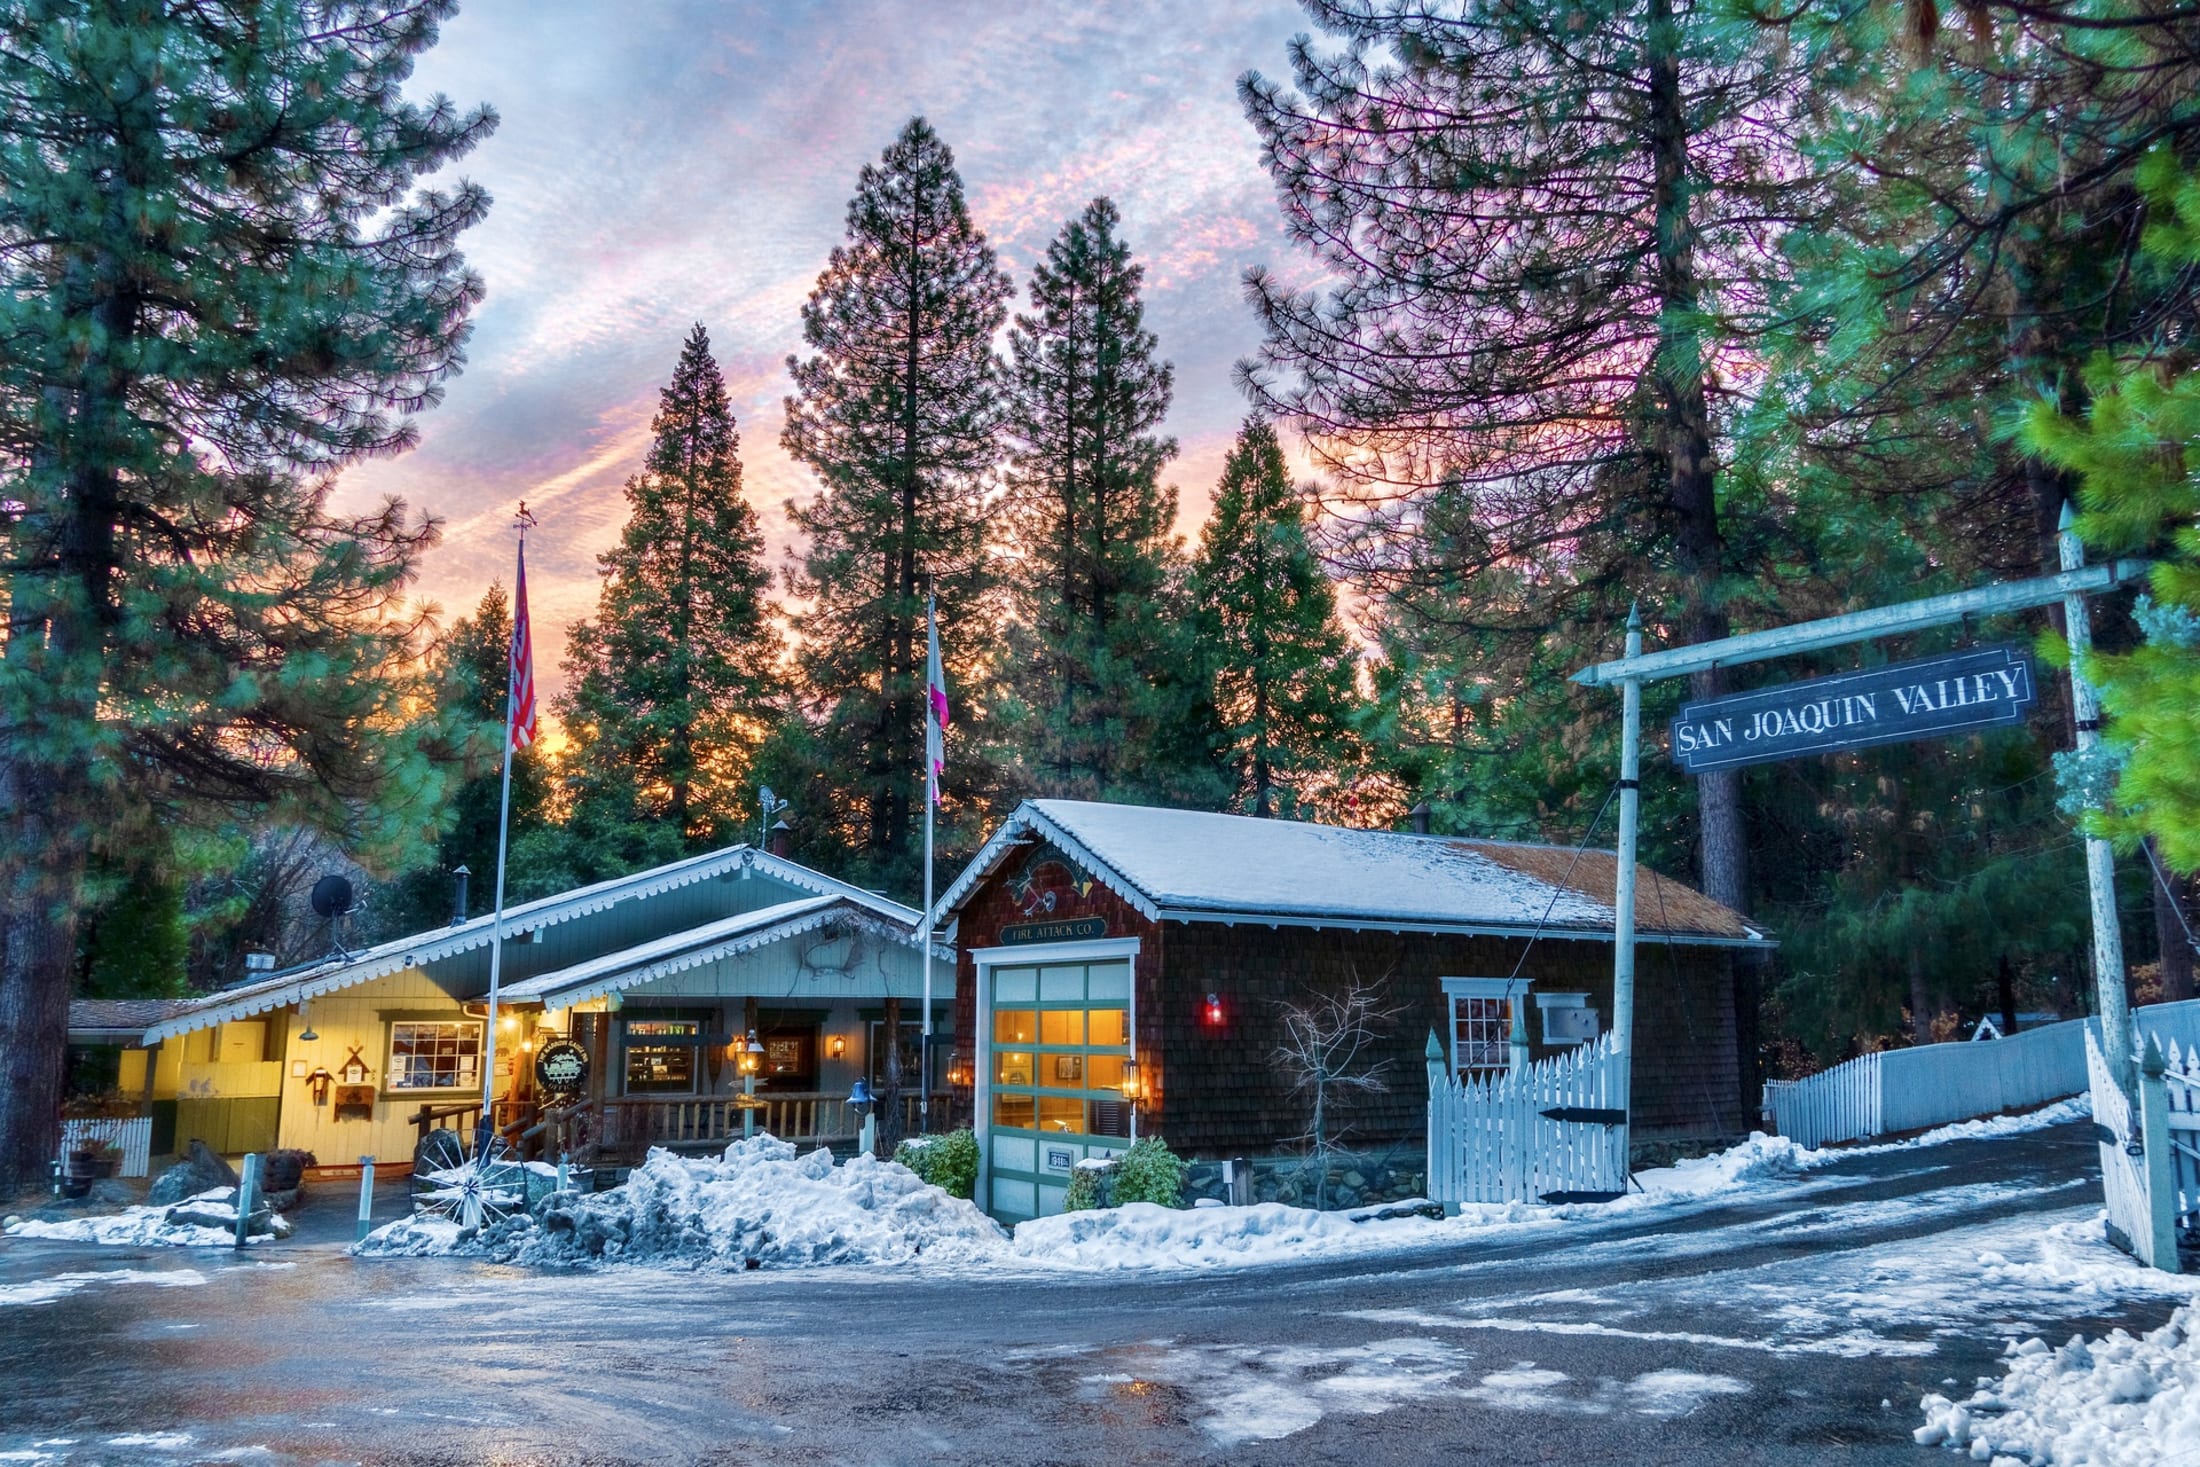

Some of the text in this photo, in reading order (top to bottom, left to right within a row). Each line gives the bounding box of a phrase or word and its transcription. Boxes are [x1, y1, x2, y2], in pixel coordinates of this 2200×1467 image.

[1679, 667, 2024, 753] SAN JOAQUIN VALLEY
[1013, 923, 1094, 940] FIRE ATTACK CO.
